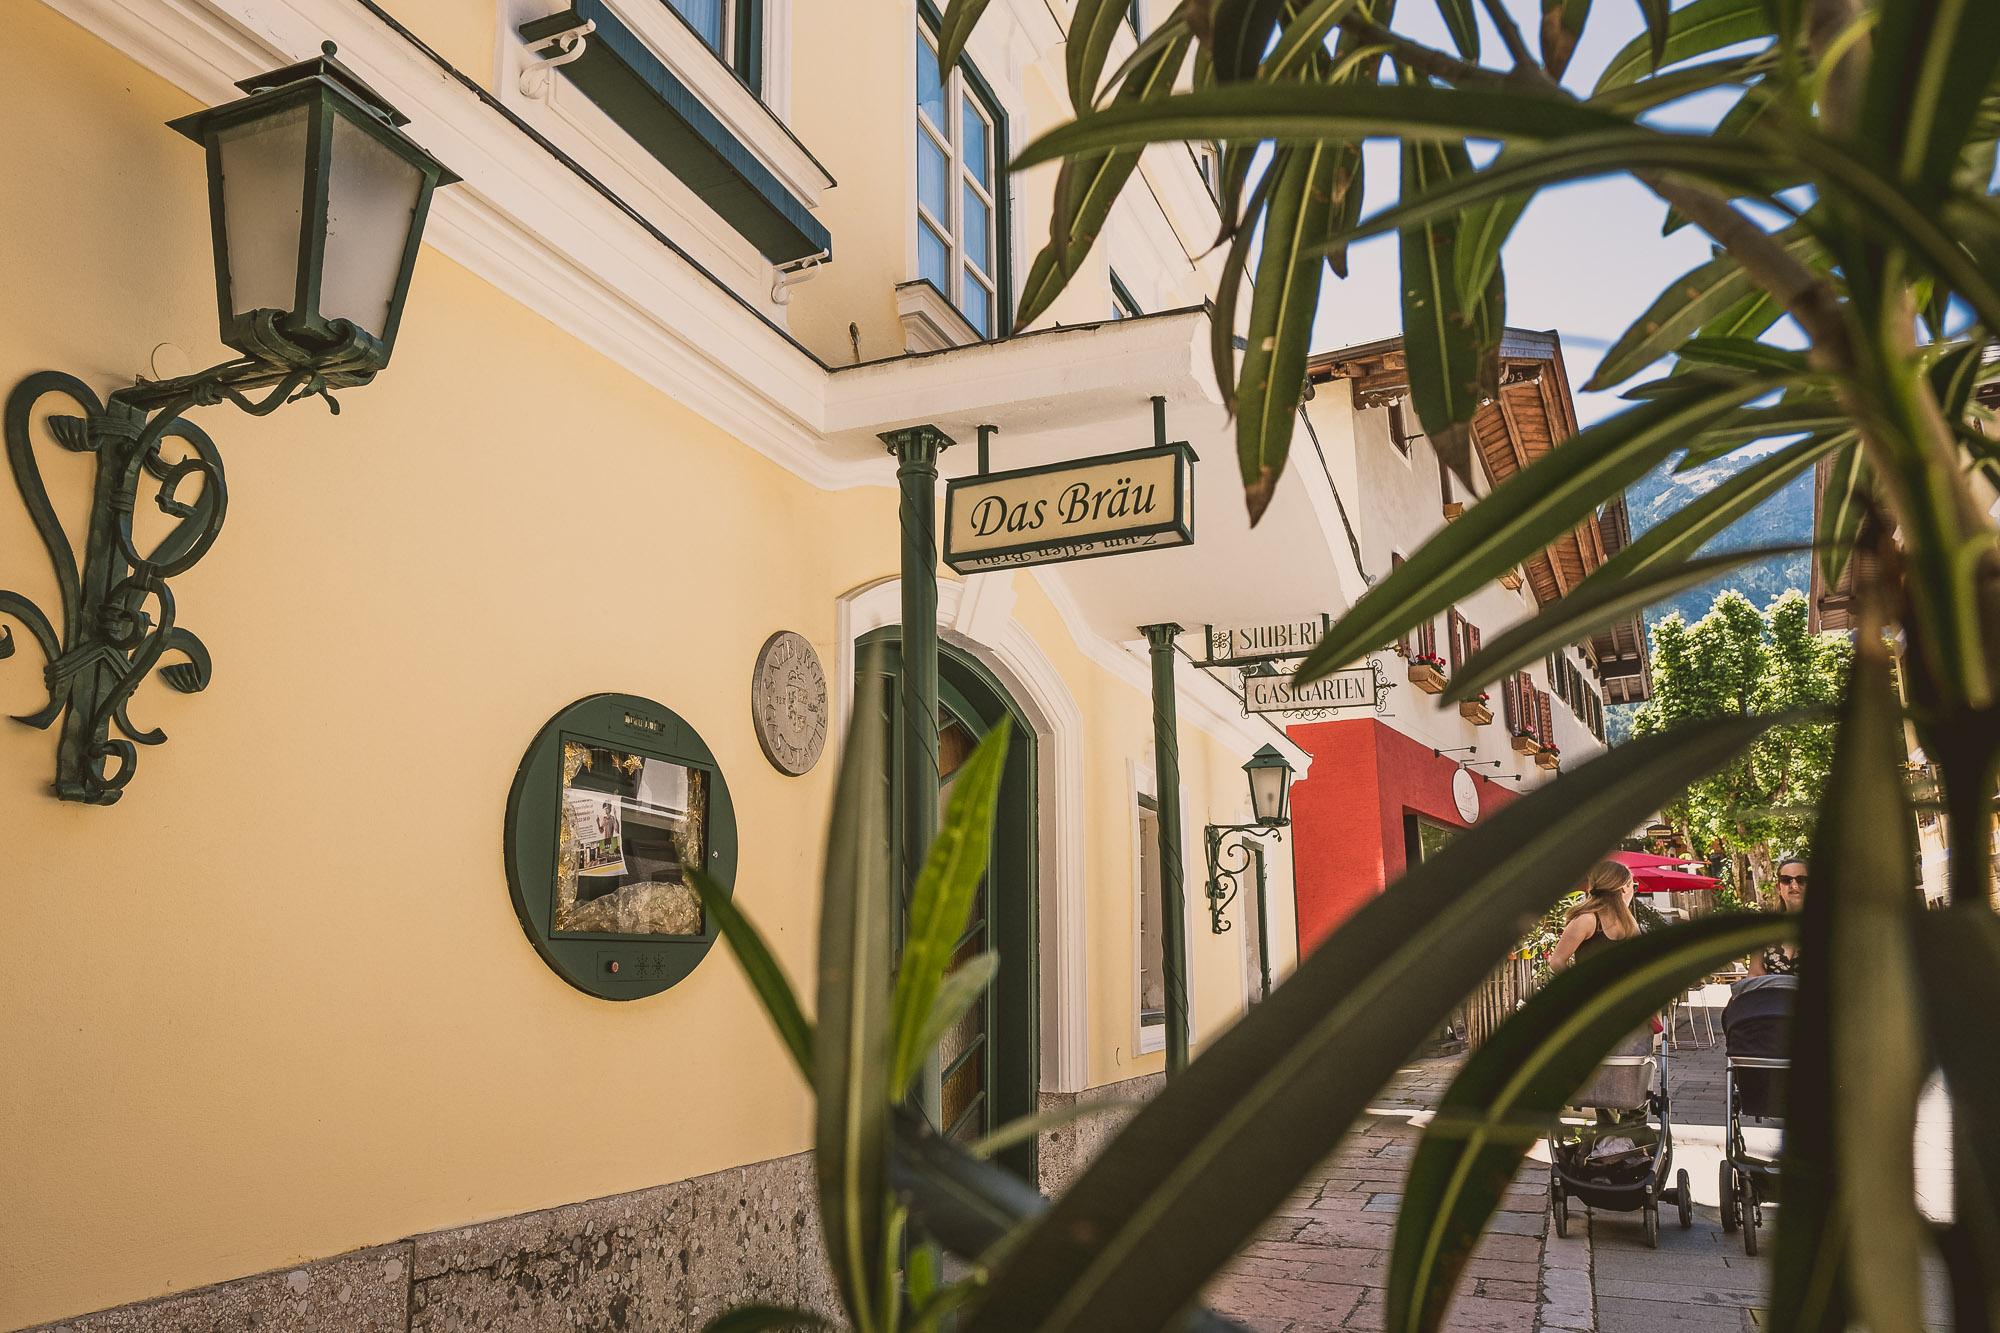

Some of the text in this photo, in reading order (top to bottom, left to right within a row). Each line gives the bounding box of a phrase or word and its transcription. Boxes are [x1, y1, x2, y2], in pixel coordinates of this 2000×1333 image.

[971, 477, 1156, 537] Das Bräu
[975, 532, 1157, 565] Zum edlen Bräu
[1254, 677, 1366, 705] GASTGARTEN
